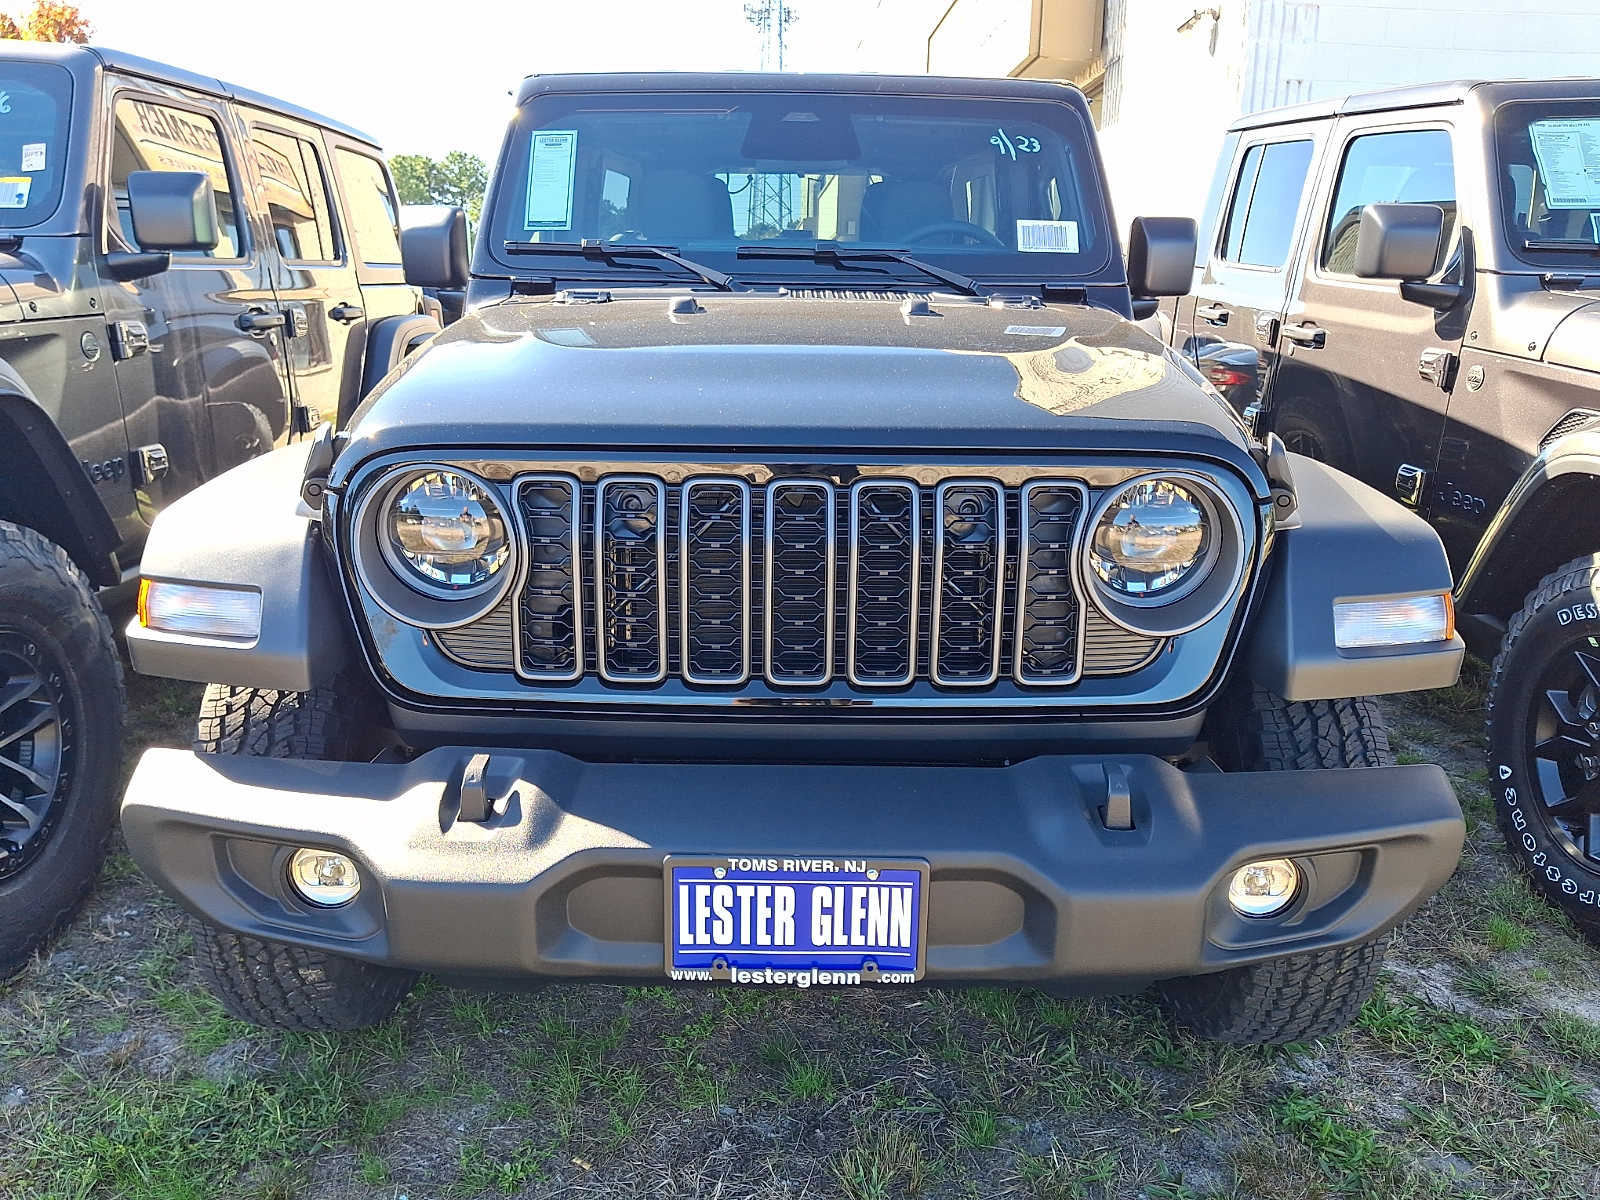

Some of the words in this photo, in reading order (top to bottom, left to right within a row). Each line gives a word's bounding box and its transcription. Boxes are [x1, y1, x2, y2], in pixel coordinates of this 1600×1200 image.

[989, 128, 1041, 161] 9/23
[1504, 787, 1600, 907] restone
[728, 858, 778, 872] TOMS
[783, 859, 840, 873] RIVER,
[844, 860, 867, 873] NJ
[679, 884, 796, 946] LESTER
[811, 886, 913, 948] GLENN
[671, 969, 713, 981] www.
[730, 966, 861, 988] lesterglenn
[877, 972, 915, 984] .com
